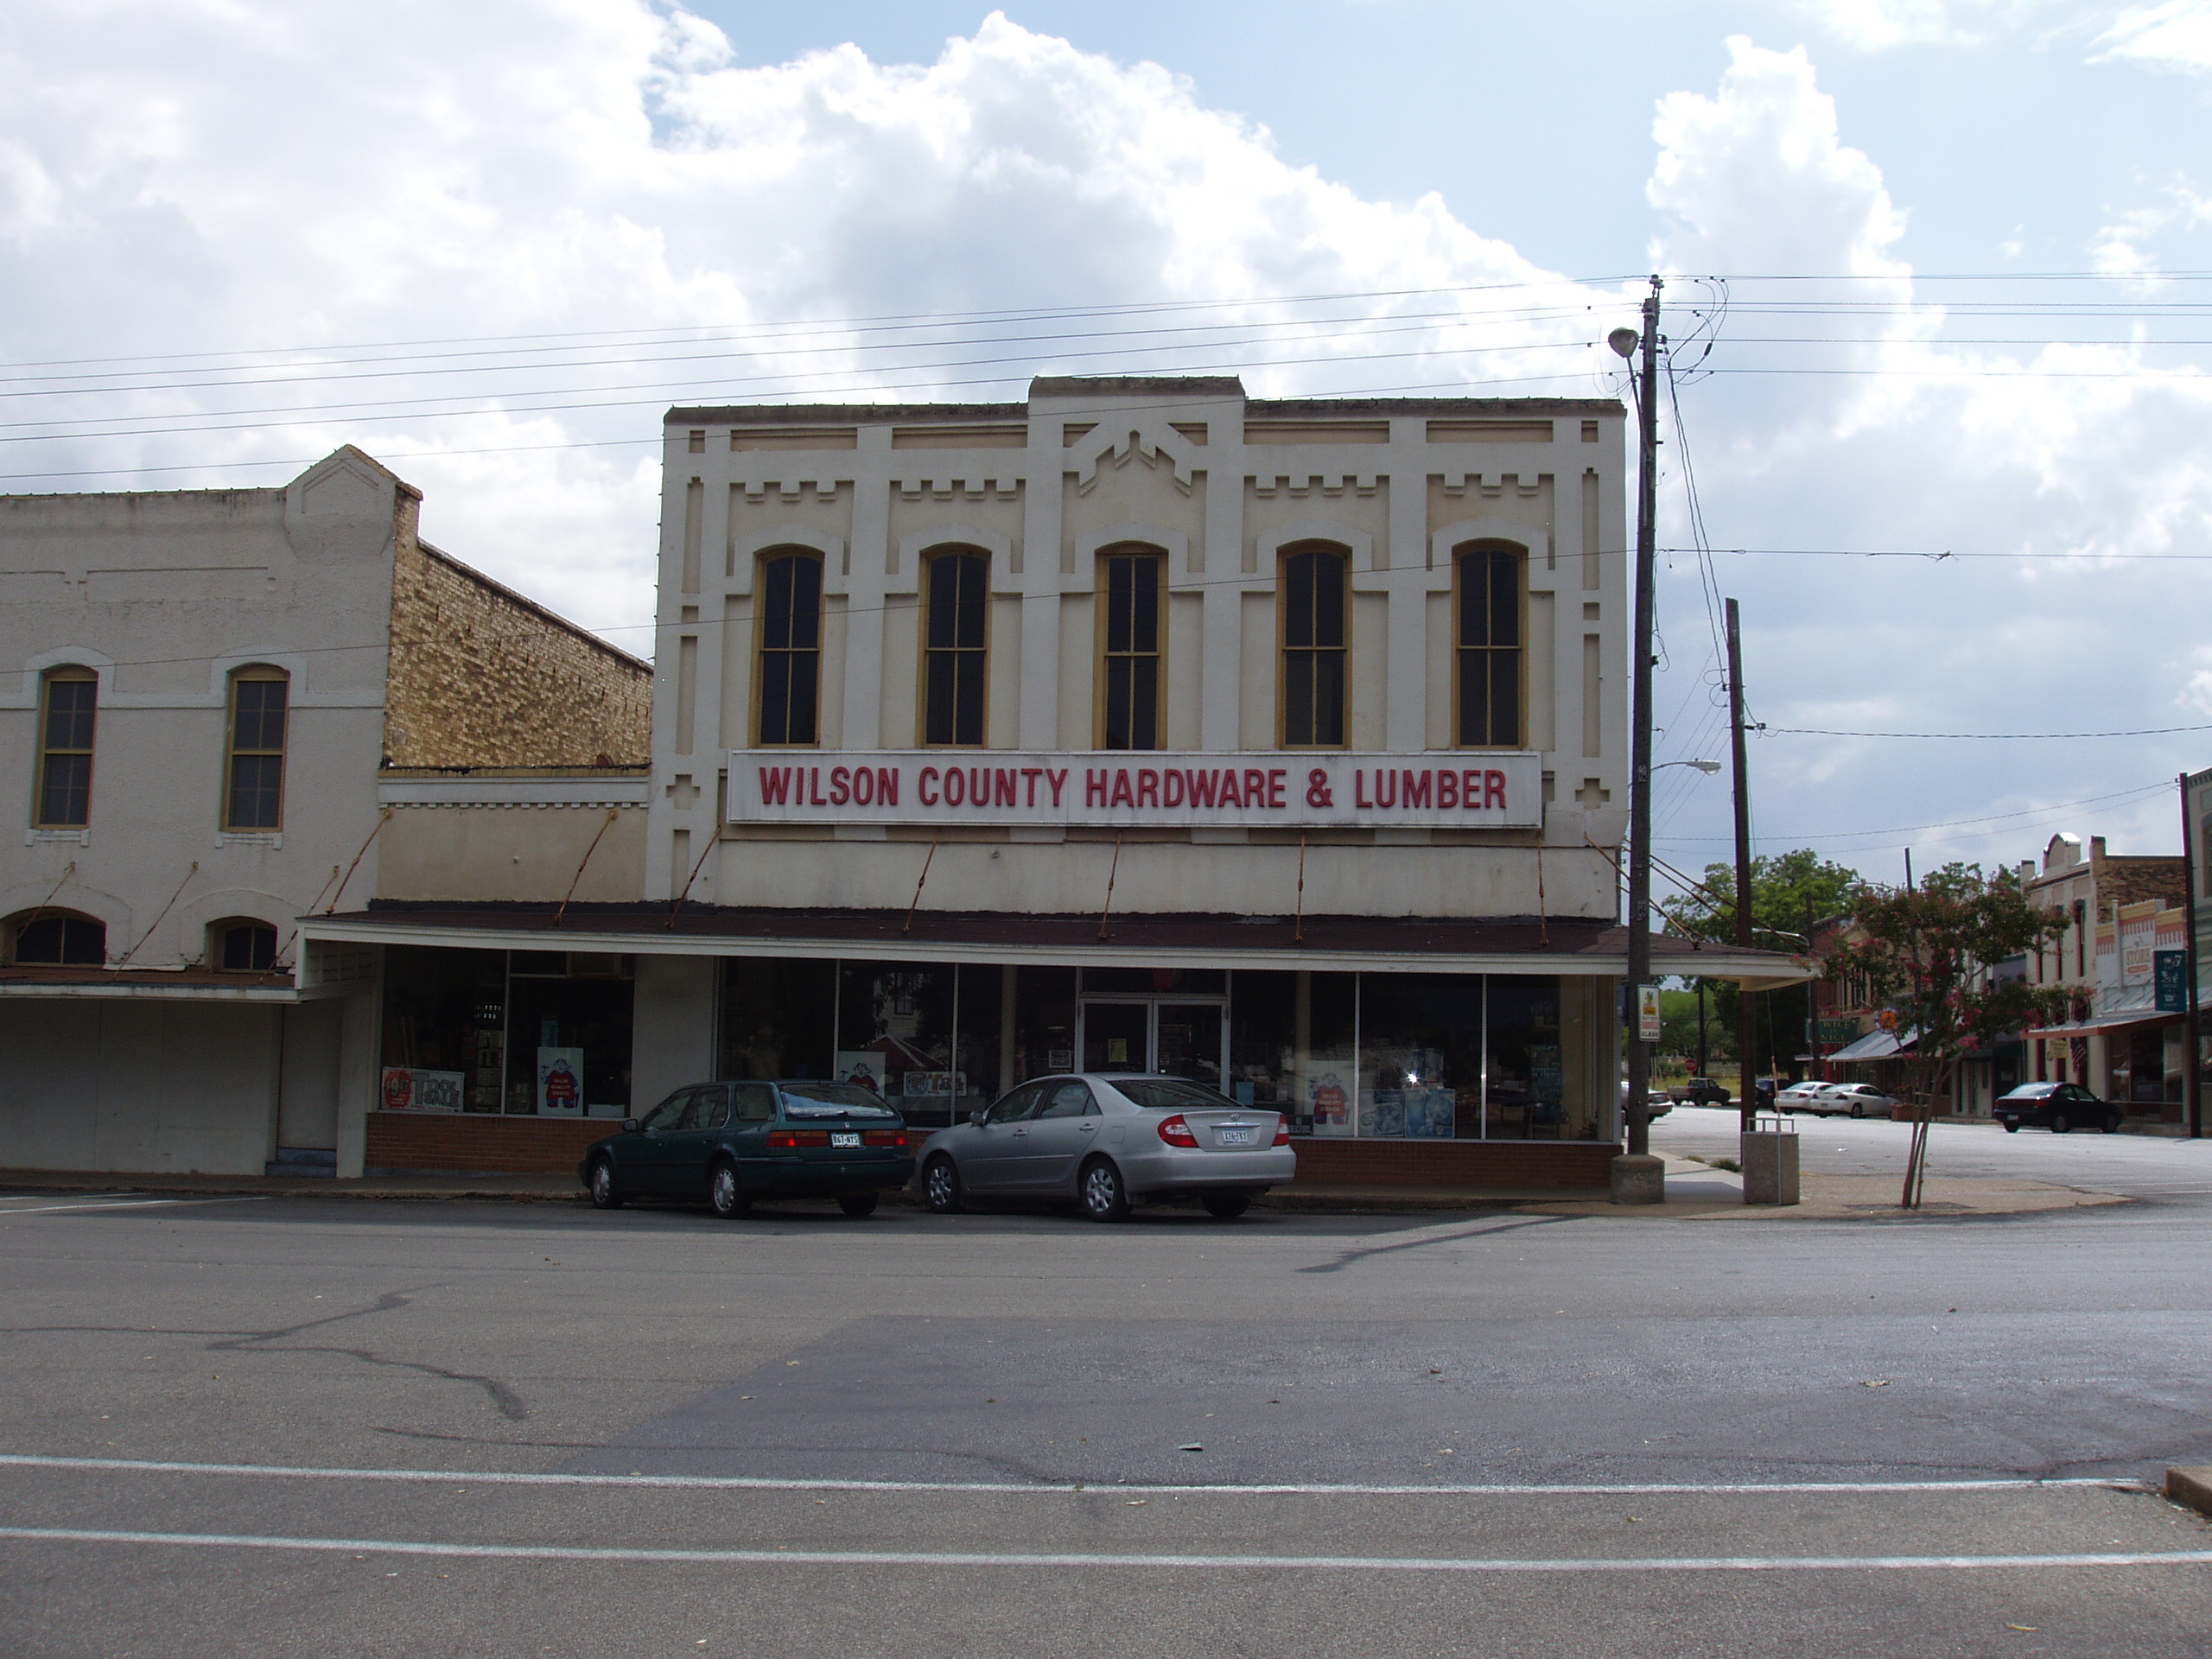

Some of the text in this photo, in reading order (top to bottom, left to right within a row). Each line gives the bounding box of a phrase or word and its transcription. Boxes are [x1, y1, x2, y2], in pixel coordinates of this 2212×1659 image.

[760, 767, 1505, 807] WILSON COUNTY HARDWARE & LUMBER
[2126, 949, 2150, 965] STORE
[411, 1072, 459, 1104] TOOL
[423, 1090, 460, 1107] SALE
